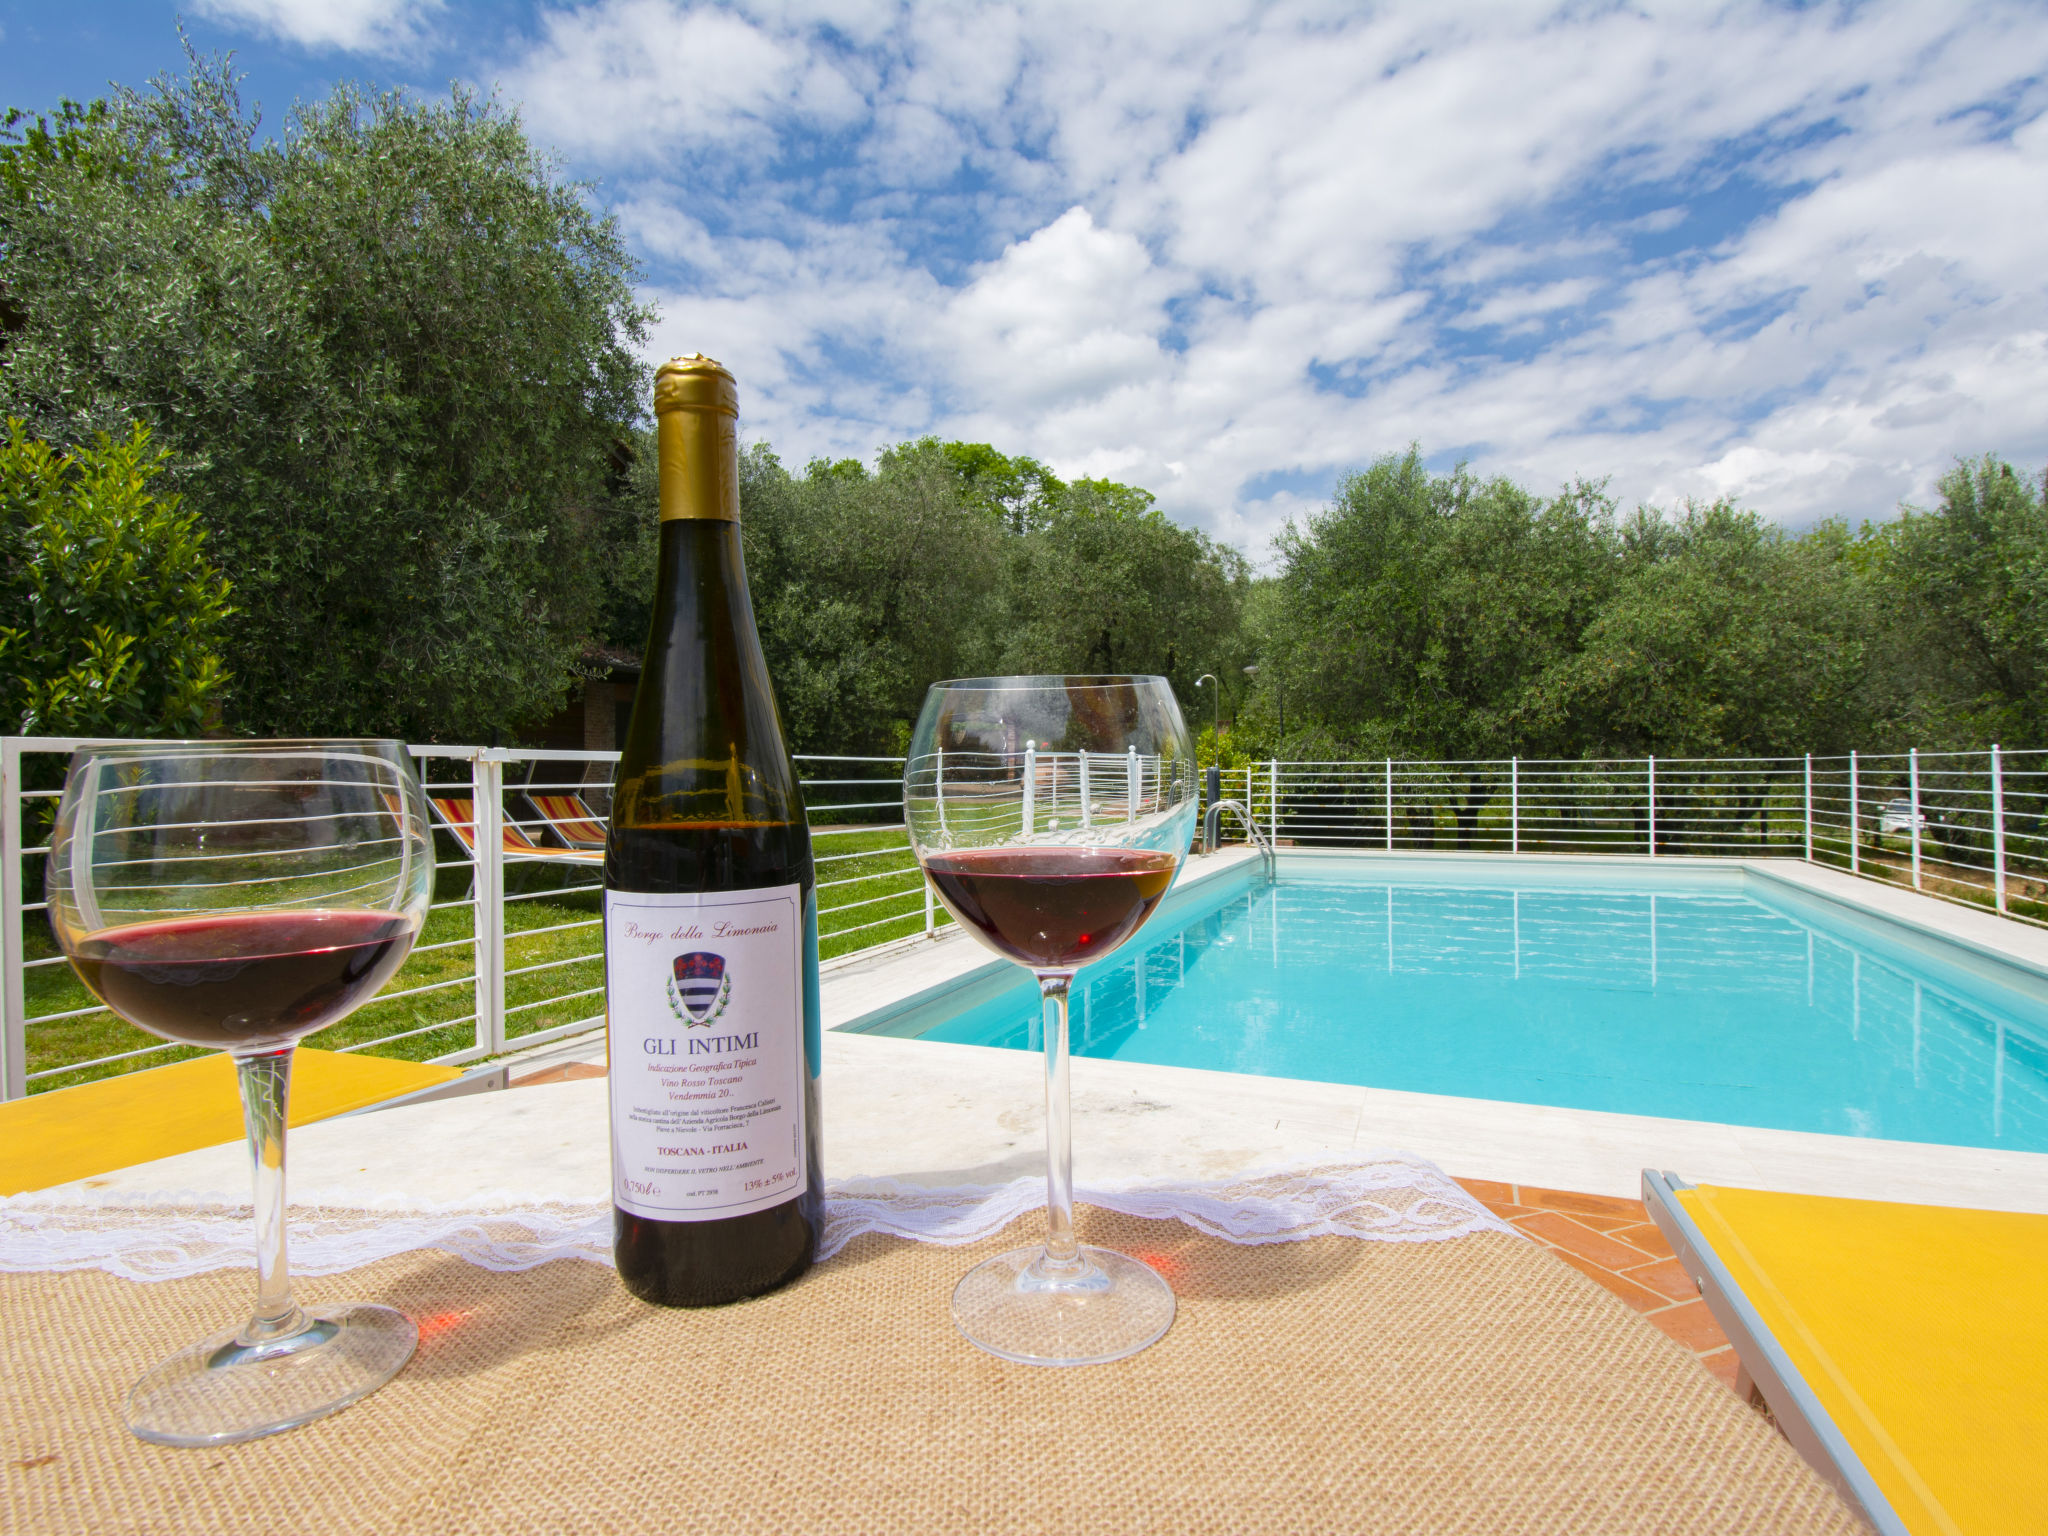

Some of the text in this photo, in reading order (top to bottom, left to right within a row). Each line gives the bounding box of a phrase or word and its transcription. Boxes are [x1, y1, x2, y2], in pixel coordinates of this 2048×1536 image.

[624, 920, 779, 945] Borgo della Limonaia
[643, 1032, 759, 1055] GLI INTIMI
[648, 1058, 757, 1074] Indicazione Geografica Tipica
[661, 1075, 743, 1088] Vino Rosso Toscano
[669, 1088, 716, 1101] Vendemmia
[657, 1146, 704, 1156] TOSCANA
[712, 1141, 748, 1154] ITALIA
[744, 1178, 763, 1192] 13%
[771, 1172, 784, 1184] 5%
